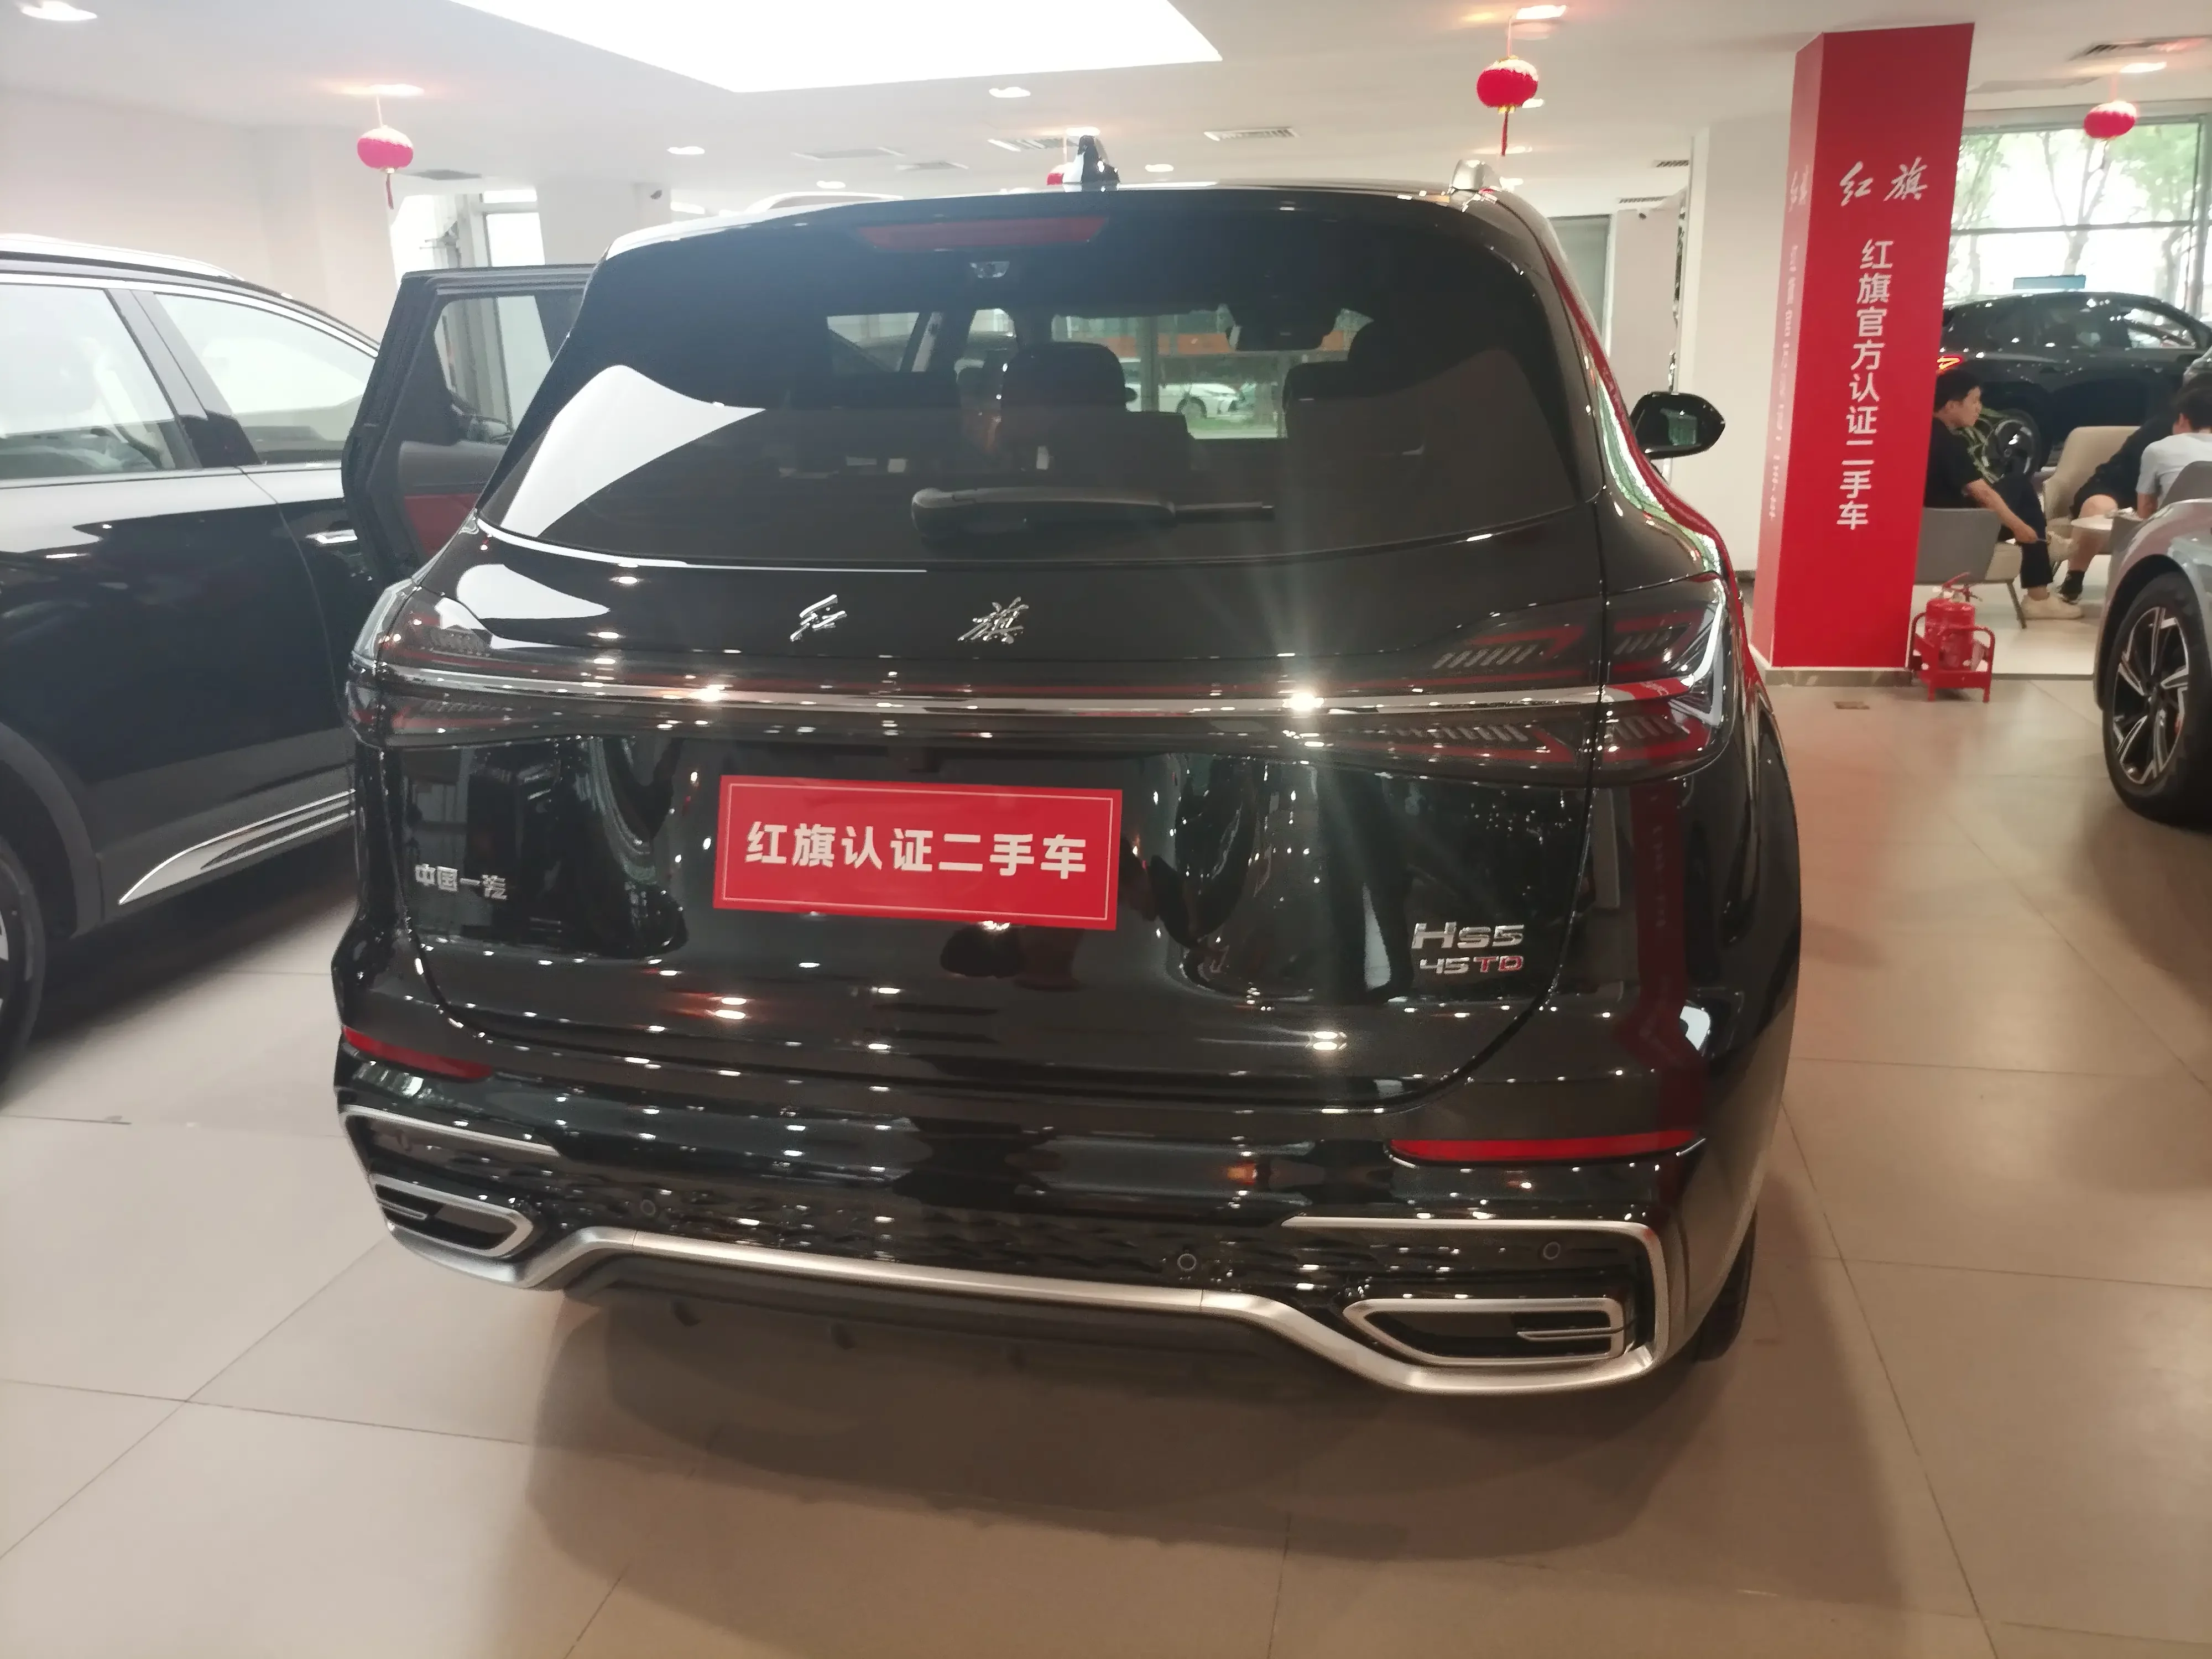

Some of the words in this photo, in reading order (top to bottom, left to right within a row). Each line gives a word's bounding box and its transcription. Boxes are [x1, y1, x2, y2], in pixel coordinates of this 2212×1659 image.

[1839, 156, 1928, 207] 红旗
[1837, 238, 1894, 530] 红旗官方认证二手车
[745, 820, 1087, 880] 红旗认证二手车
[415, 863, 508, 900] 中国一汽
[1411, 921, 1525, 949] HS5
[1420, 956, 1524, 974] 45TD
